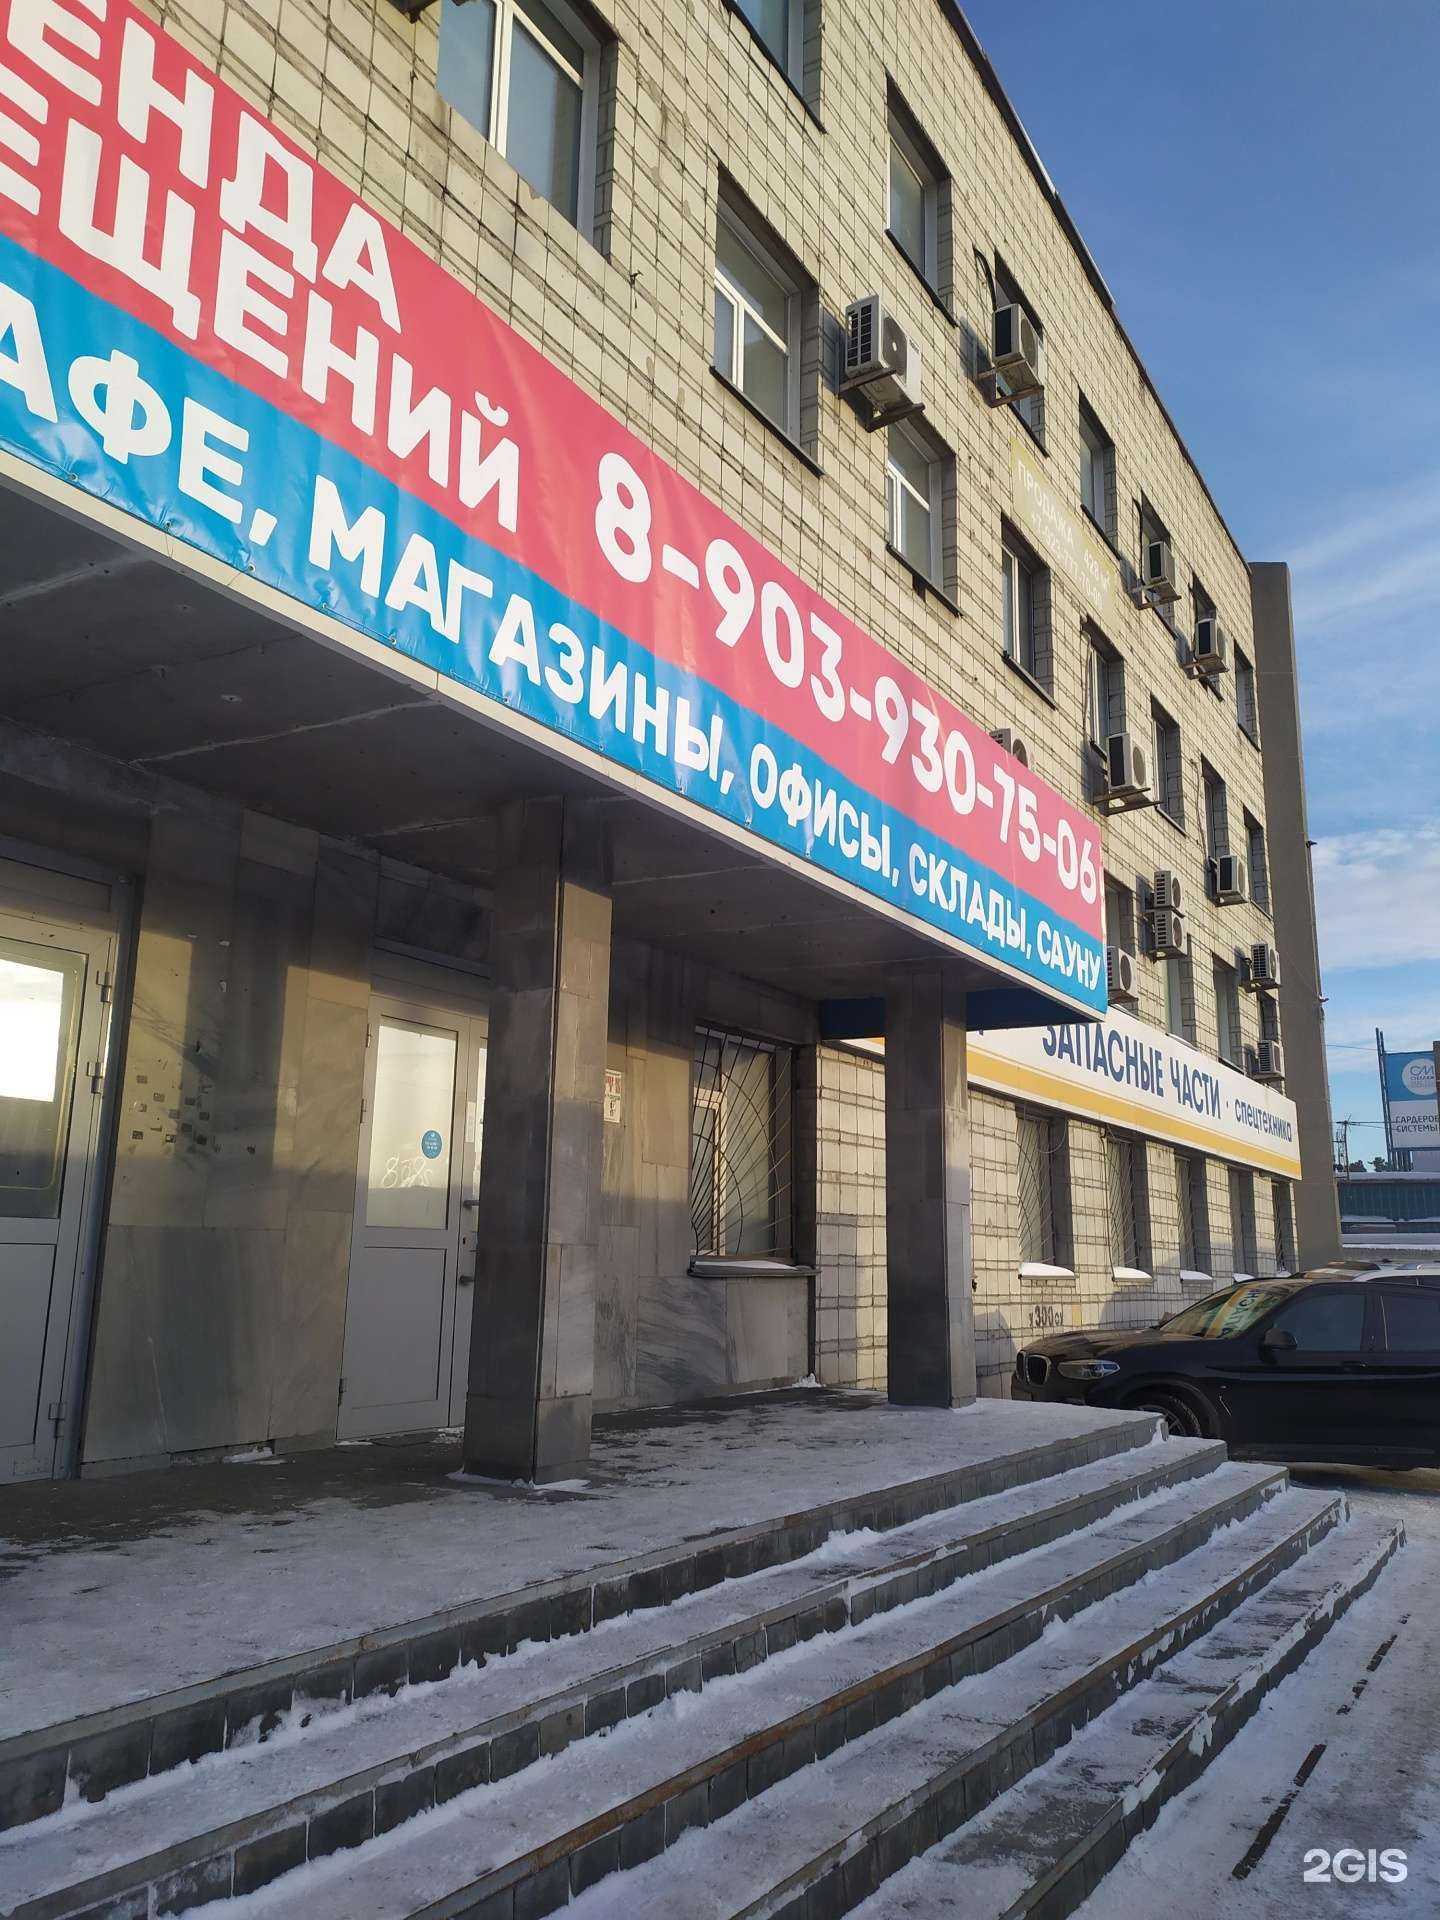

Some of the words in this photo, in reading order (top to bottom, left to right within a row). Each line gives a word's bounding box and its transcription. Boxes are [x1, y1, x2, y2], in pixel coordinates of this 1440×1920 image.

[7, 0, 401, 334] ЕНДА
[1017, 459, 1074, 545] ПРОДАЖА
[0, 283, 278, 546] АФЕ,
[309, 475, 735, 795] МАГАЗИНЫ,
[750, 743, 900, 887] ОФИСЫ,
[909, 843, 1032, 960] СКЛАДЫ,
[1037, 921, 1101, 990] САУНУ
[595, 453, 1096, 905] 8-903-930-75-06
[1042, 1022, 1164, 1098] ЗАПАСНЫЕ
[1170, 1056, 1221, 1120] ЧАСТИ
[1234, 1098, 1292, 1142] спецтехника
[1396, 1124, 1438, 1133] СИСТЕМЫ
